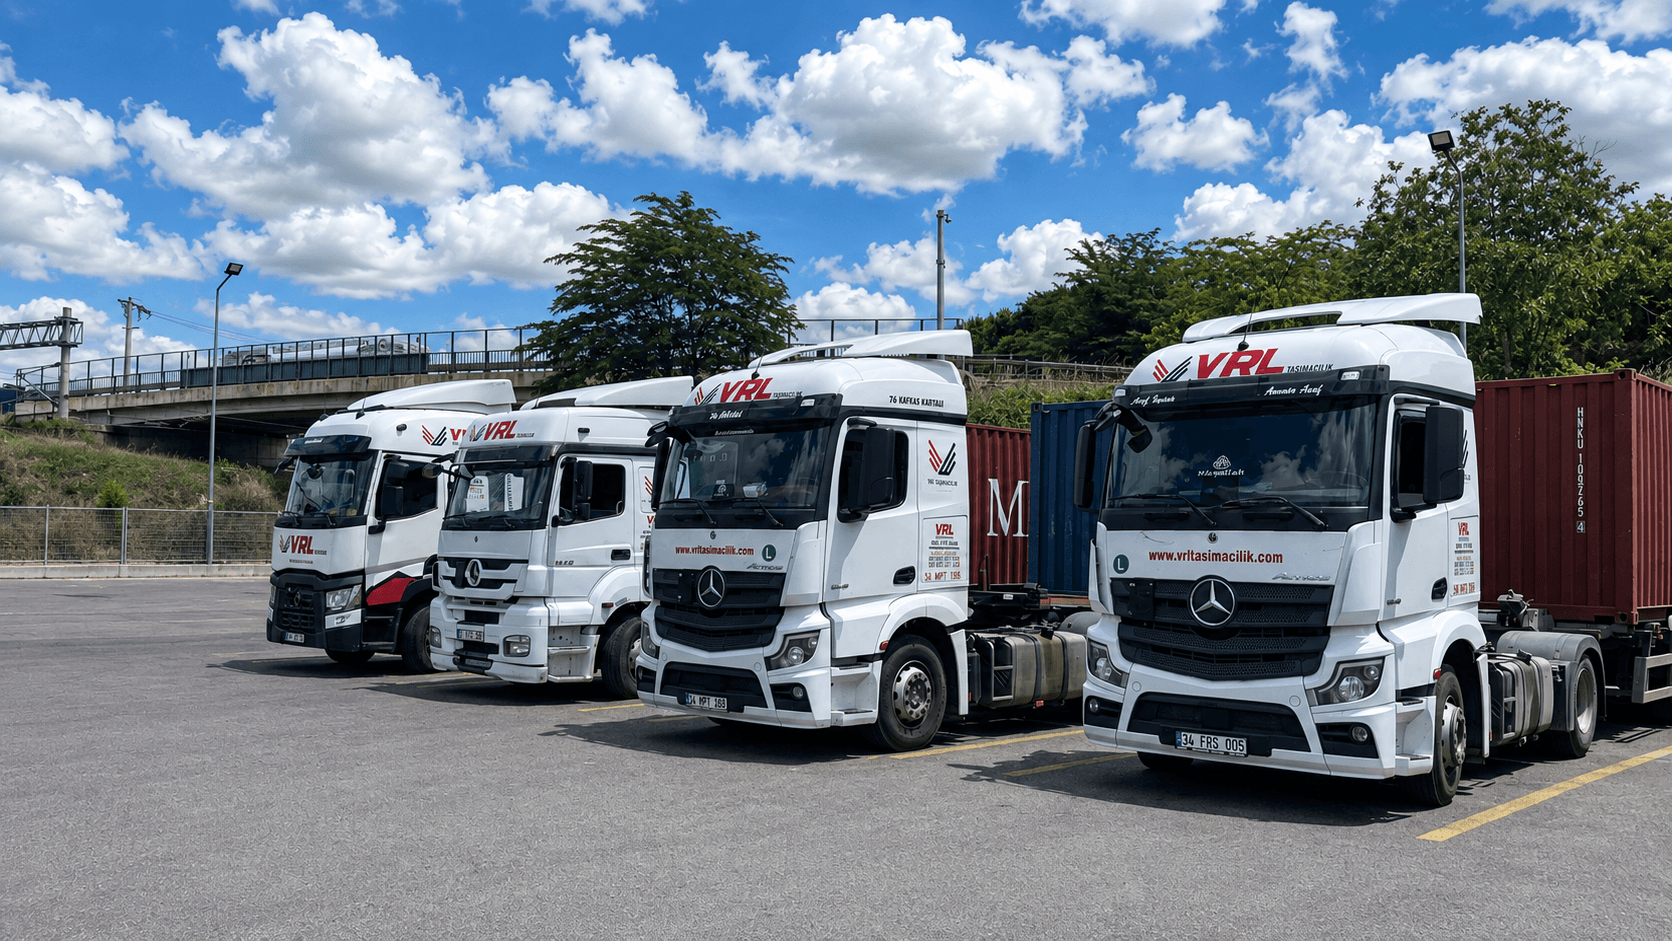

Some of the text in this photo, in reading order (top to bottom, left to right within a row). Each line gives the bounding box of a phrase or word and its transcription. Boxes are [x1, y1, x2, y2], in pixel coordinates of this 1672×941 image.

[1197, 348, 1284, 379] VRL
[721, 378, 773, 403] VRL
[889, 395, 898, 404] 76
[484, 420, 518, 440] VRL
[986, 478, 1029, 537] M
[935, 523, 954, 536] VRL
[1577, 522, 1584, 533] 4
[291, 535, 314, 554] VRL
[1149, 549, 1284, 564] www.vrltasimacilik.com
[1182, 733, 1245, 752] 34 FRS 005
